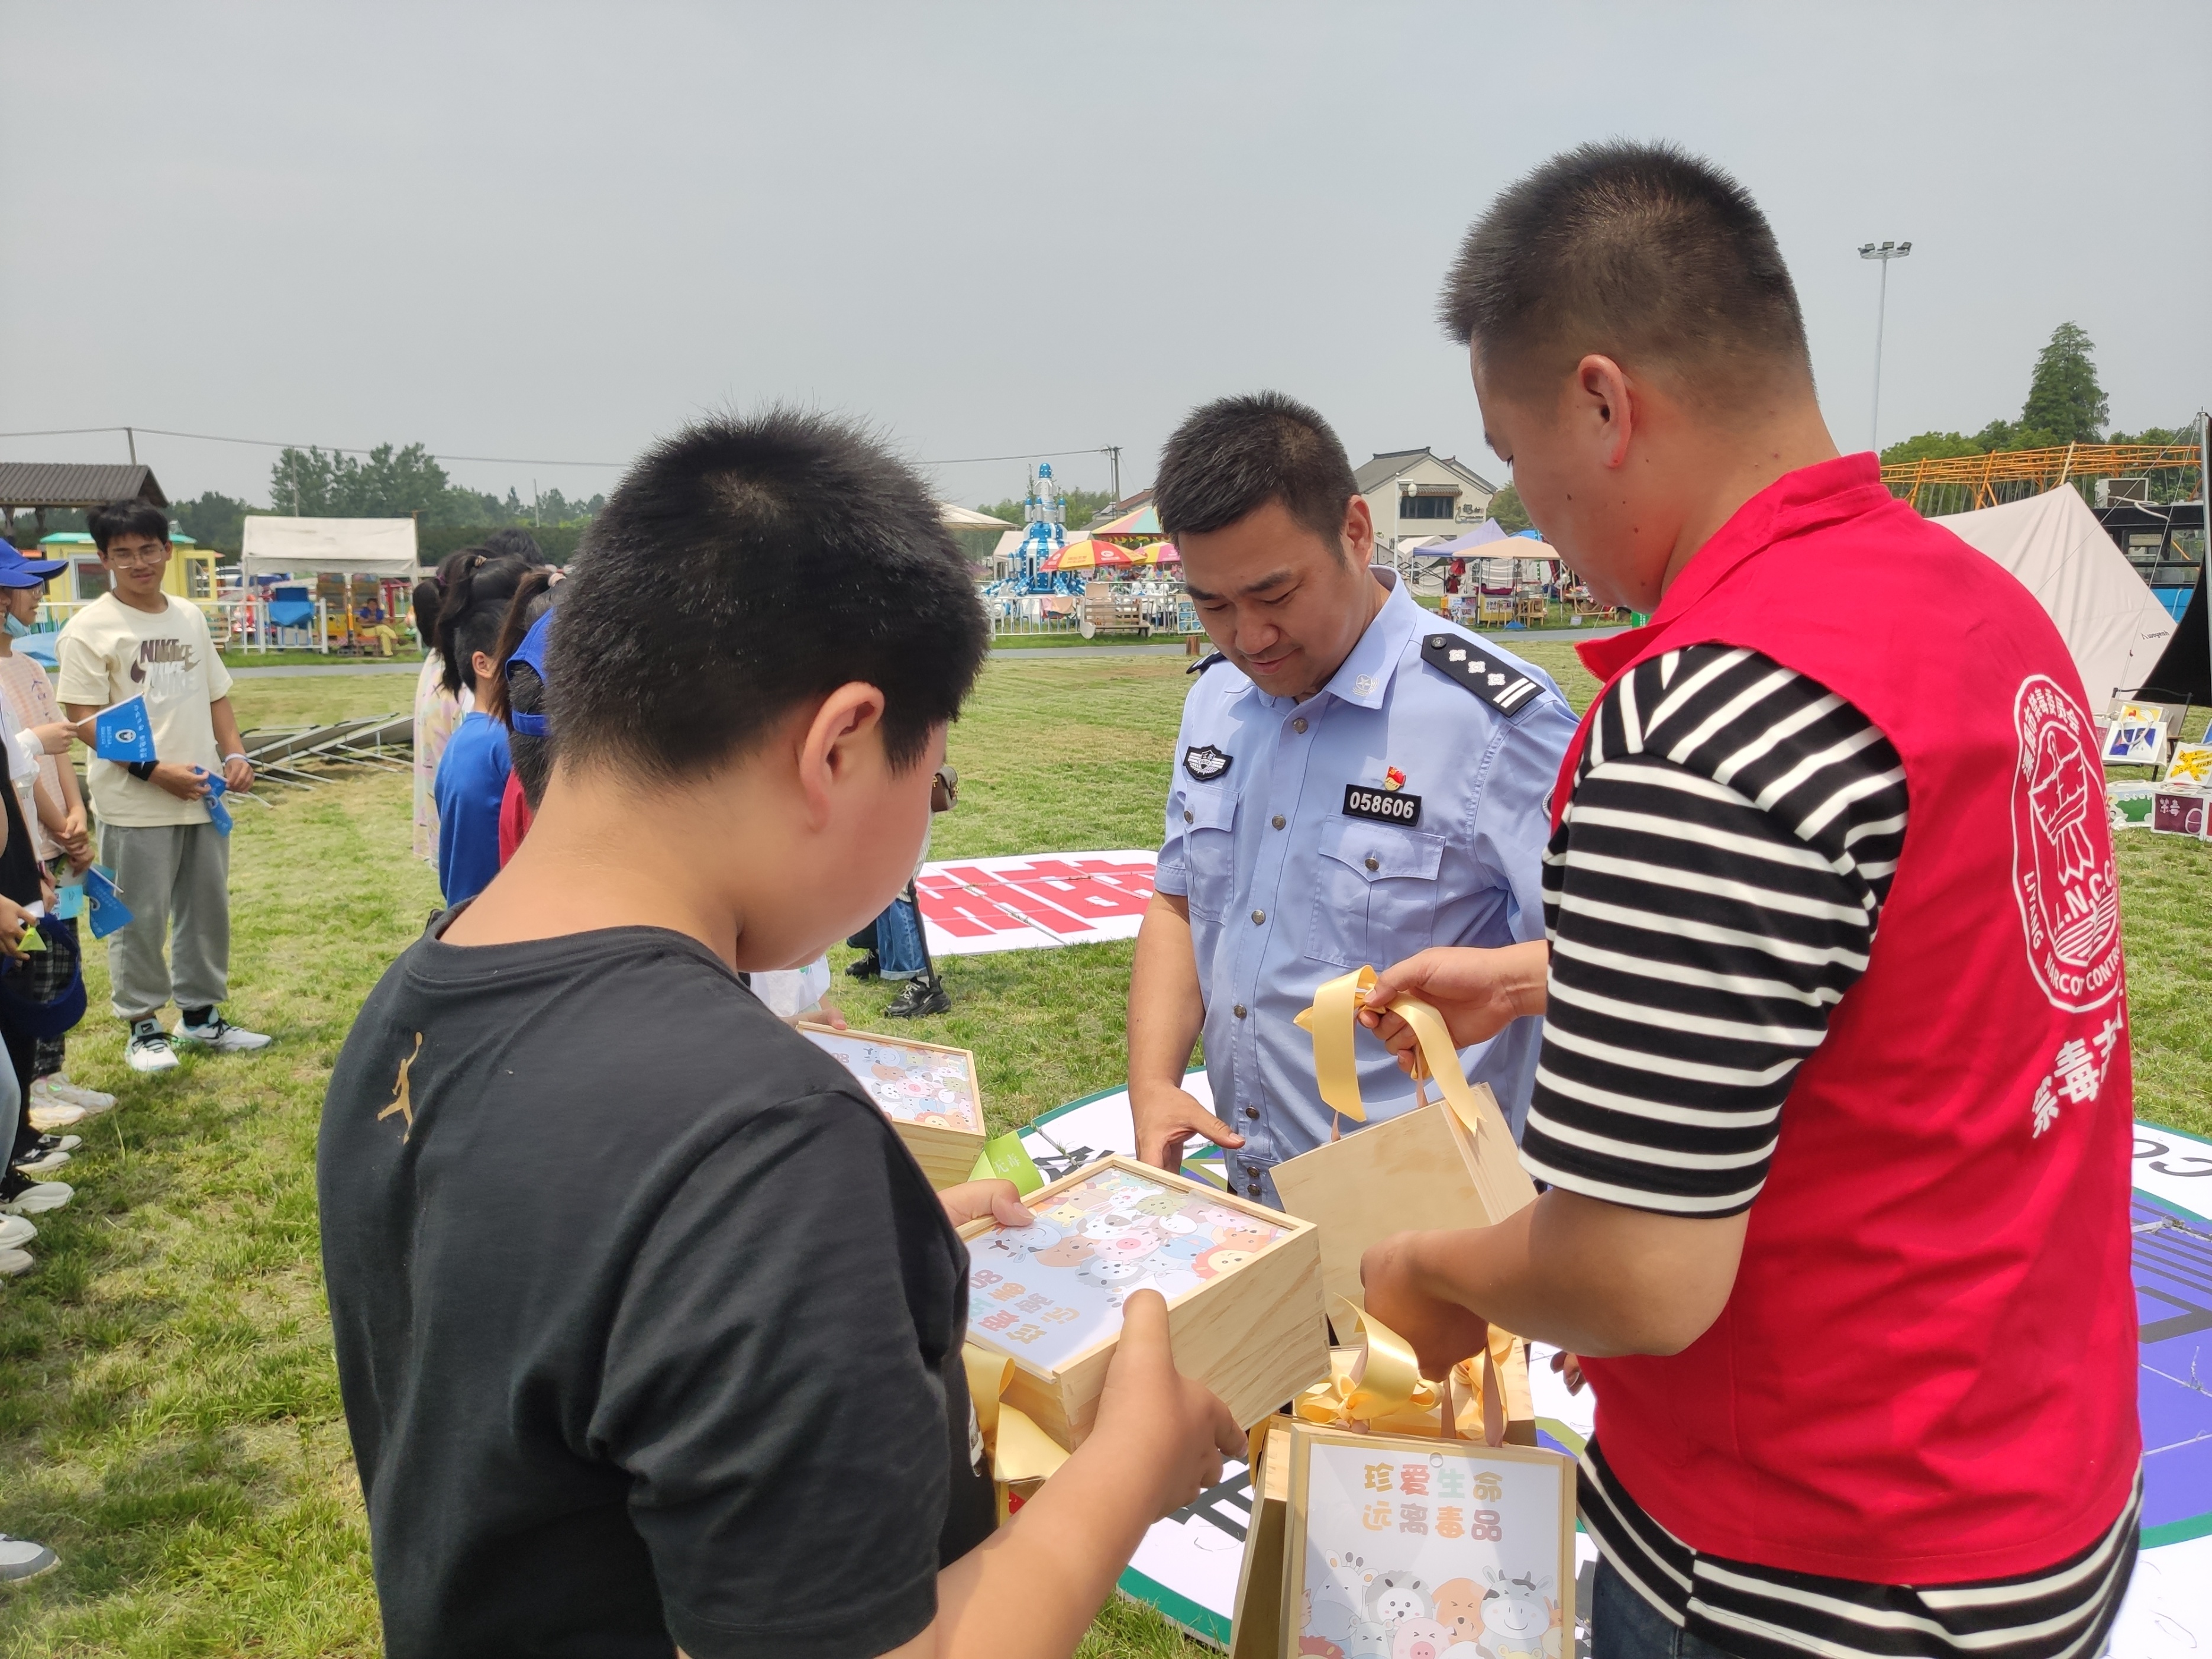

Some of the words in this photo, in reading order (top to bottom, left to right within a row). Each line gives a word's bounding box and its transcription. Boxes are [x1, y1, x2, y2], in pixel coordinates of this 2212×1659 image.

[1349, 792, 1415, 819] 058606
[2159, 797, 2181, 816] 禁毒
[2023, 870, 2044, 950] LIYANG
[994, 1153, 1021, 1175] 无毒
[1364, 1462, 1503, 1503] 珍爱生命
[1362, 1500, 1503, 1542] 远离毒品
